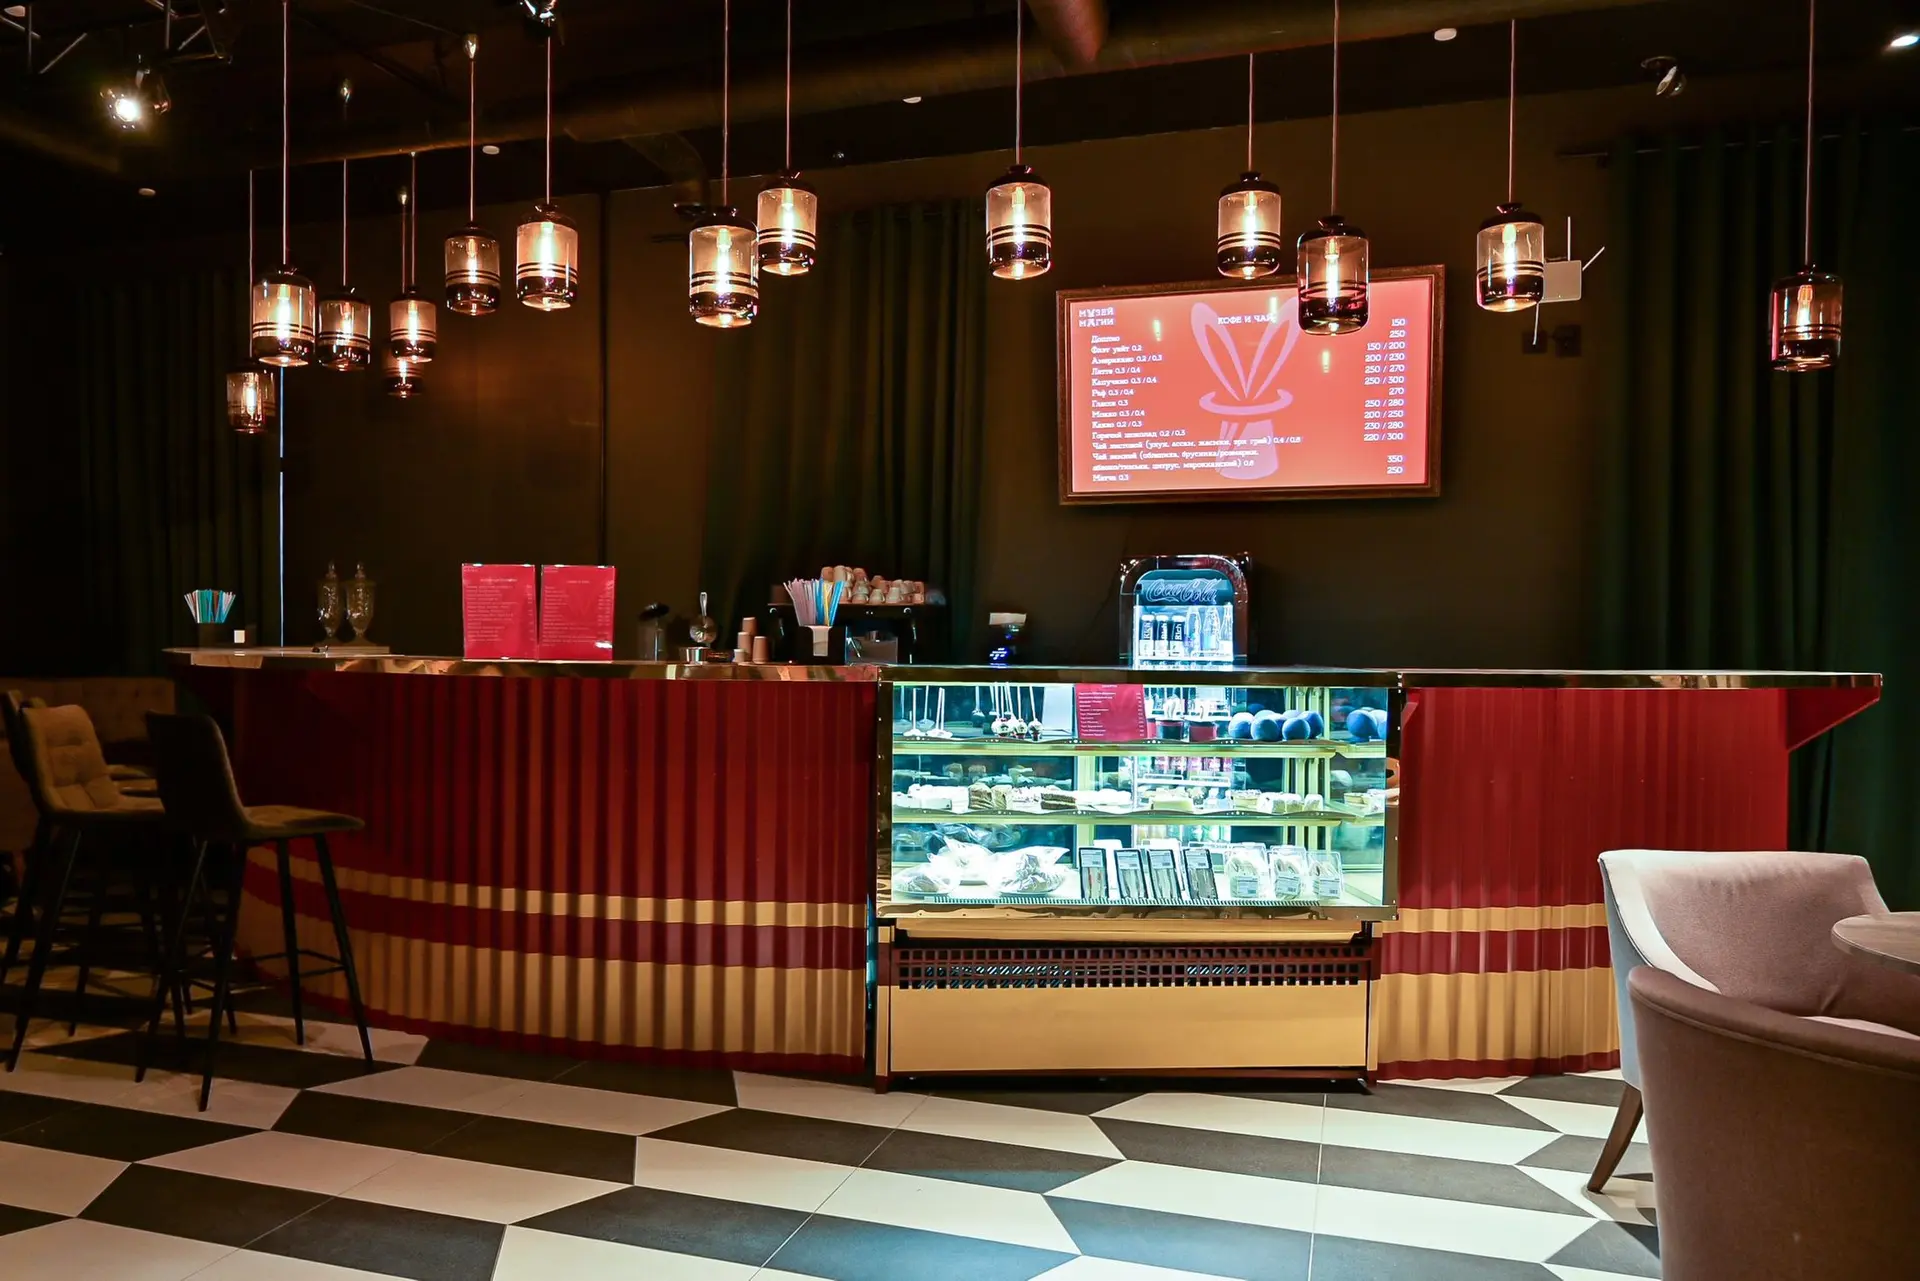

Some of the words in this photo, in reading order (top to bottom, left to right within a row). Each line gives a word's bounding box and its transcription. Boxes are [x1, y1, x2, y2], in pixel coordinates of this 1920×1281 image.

[1079, 307, 1114, 317] МУЗЕЙ
[1079, 319, 1114, 327] МАГИИ
[1217, 316, 1242, 325] КОФЕ
[1391, 318, 1406, 327] 150
[1389, 330, 1406, 338] 250
[1367, 342, 1381, 351] 150
[1388, 341, 1405, 349] 200
[1365, 354, 1381, 362] 200
[1365, 365, 1381, 374] 250
[1389, 364, 1405, 372] 270
[1364, 377, 1380, 385] 250
[1388, 375, 1405, 384] 300
[1389, 387, 1405, 395] 270
[1364, 399, 1380, 408] 250
[1364, 411, 1380, 419] 200
[1388, 410, 1404, 418] 250
[1363, 433, 1379, 441] 220
[1387, 432, 1404, 440] 300
[1387, 455, 1403, 463] 350
[1387, 466, 1403, 474] 250
